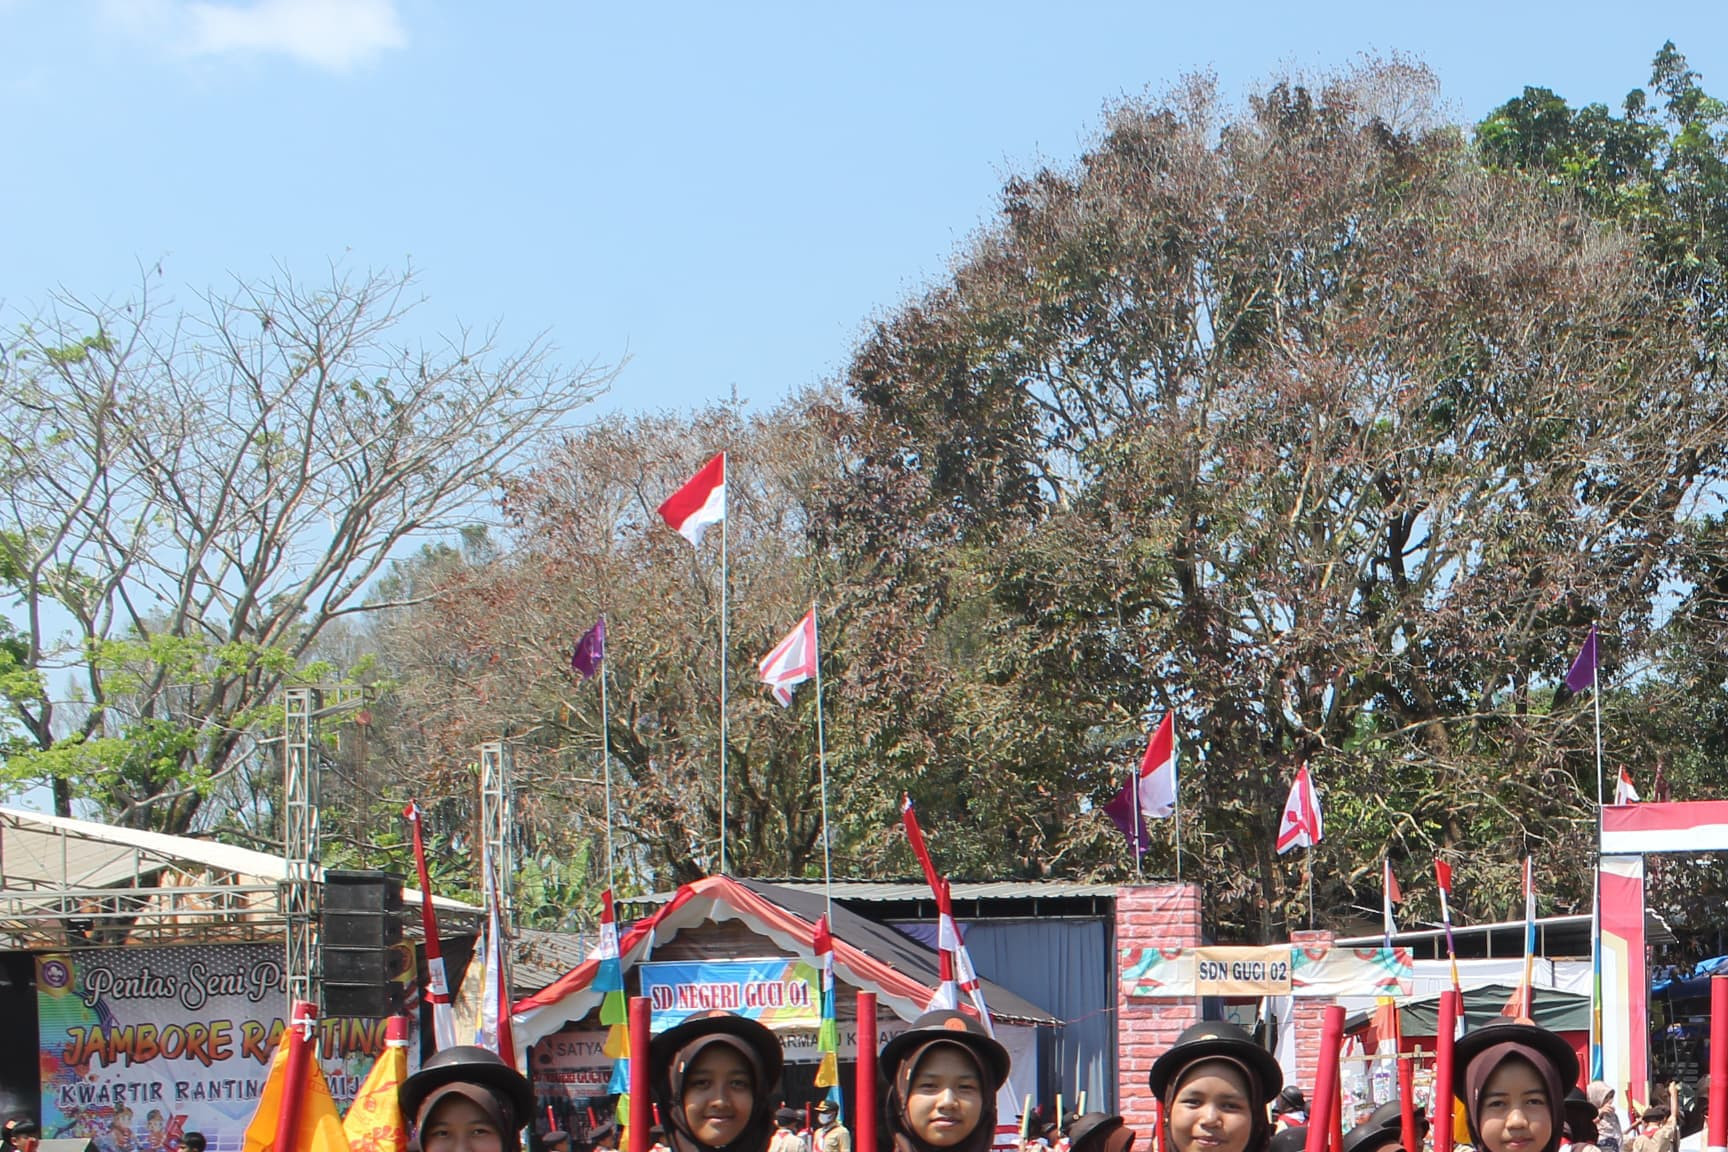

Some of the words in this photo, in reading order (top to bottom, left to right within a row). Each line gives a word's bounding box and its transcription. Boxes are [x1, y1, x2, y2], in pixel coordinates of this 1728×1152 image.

[84, 966, 176, 1007] Pentas
[178, 960, 249, 1013] Seni
[1199, 962, 1228, 980] SDN
[1232, 962, 1266, 981] GUCI
[1270, 962, 1288, 981] 02
[651, 985, 673, 1011] SD
[677, 981, 740, 1010] NEGERI
[745, 980, 785, 1008] GUCI
[789, 980, 810, 1007] 01
[63, 1017, 233, 1068] JAMBORE
[60, 1080, 163, 1105] KWARTIR
